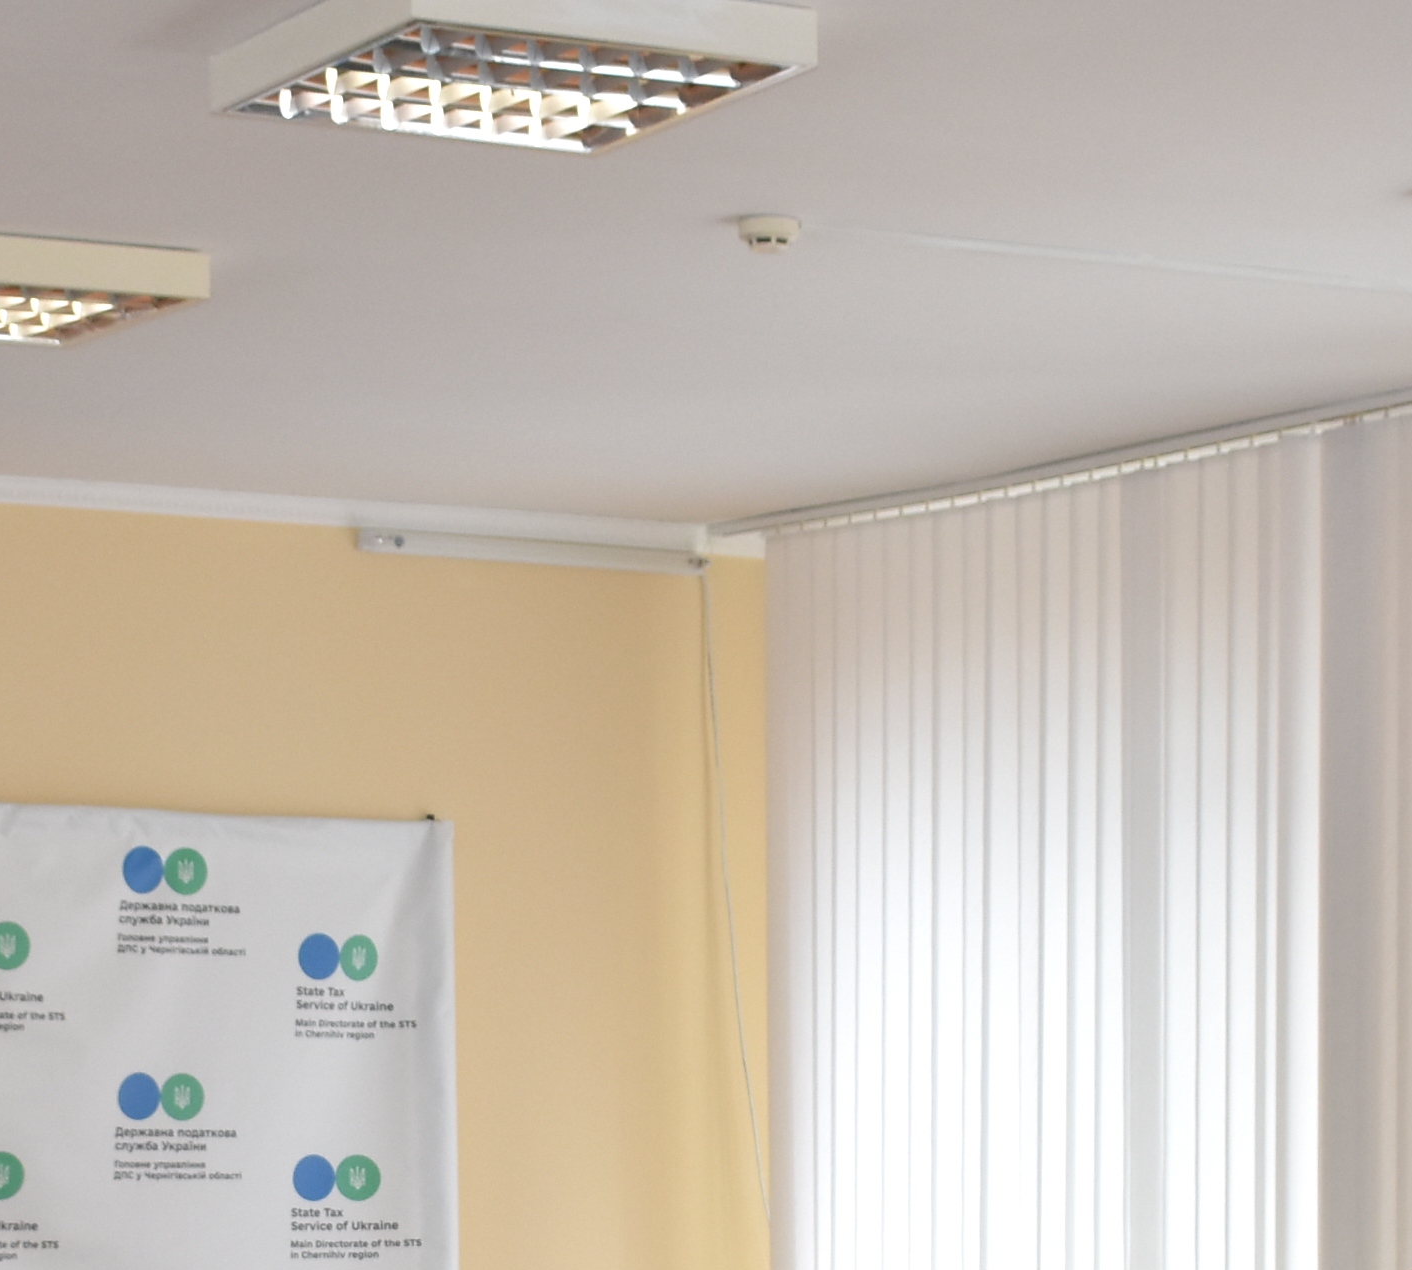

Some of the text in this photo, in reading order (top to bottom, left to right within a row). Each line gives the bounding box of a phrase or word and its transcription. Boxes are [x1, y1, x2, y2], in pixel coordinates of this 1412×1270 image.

[120, 900, 240, 914] Державна податкова
[119, 915, 209, 927] служба України
[117, 933, 209, 944] Головне управління
[118, 944, 137, 953] ДПС
[149, 945, 209, 955] Чернігівській
[212, 948, 246, 956] області
[0, 991, 44, 1002] Ukraine
[296, 986, 344, 997] State Tax
[296, 1000, 393, 1011] Service of Ukraine
[18, 1010, 27, 1020] of
[31, 1011, 45, 1020] the
[48, 1012, 65, 1020] STS
[319, 1020, 365, 1028] Directorate
[399, 1020, 417, 1028] STS
[295, 1030, 374, 1040] in Chernihiv region
[115, 1127, 236, 1138] Державна податкова
[115, 1140, 206, 1152] служба України
[114, 1160, 205, 1169] Головне управління
[114, 1172, 134, 1180] ДПС
[145, 1172, 206, 1180] Чернігівській
[209, 1172, 242, 1180] області
[291, 1208, 343, 1217] State Tax
[291, 1220, 398, 1230] Service of Ukraine
[11, 1241, 20, 1249] of
[23, 1241, 38, 1249] the
[42, 1241, 59, 1249] STS
[290, 1240, 313, 1248] Main
[315, 1240, 369, 1248] Directorate
[385, 1239, 401, 1247] the
[403, 1238, 422, 1246] STS
[301, 1251, 345, 1259] Chernihiv
[349, 1251, 379, 1260] region
